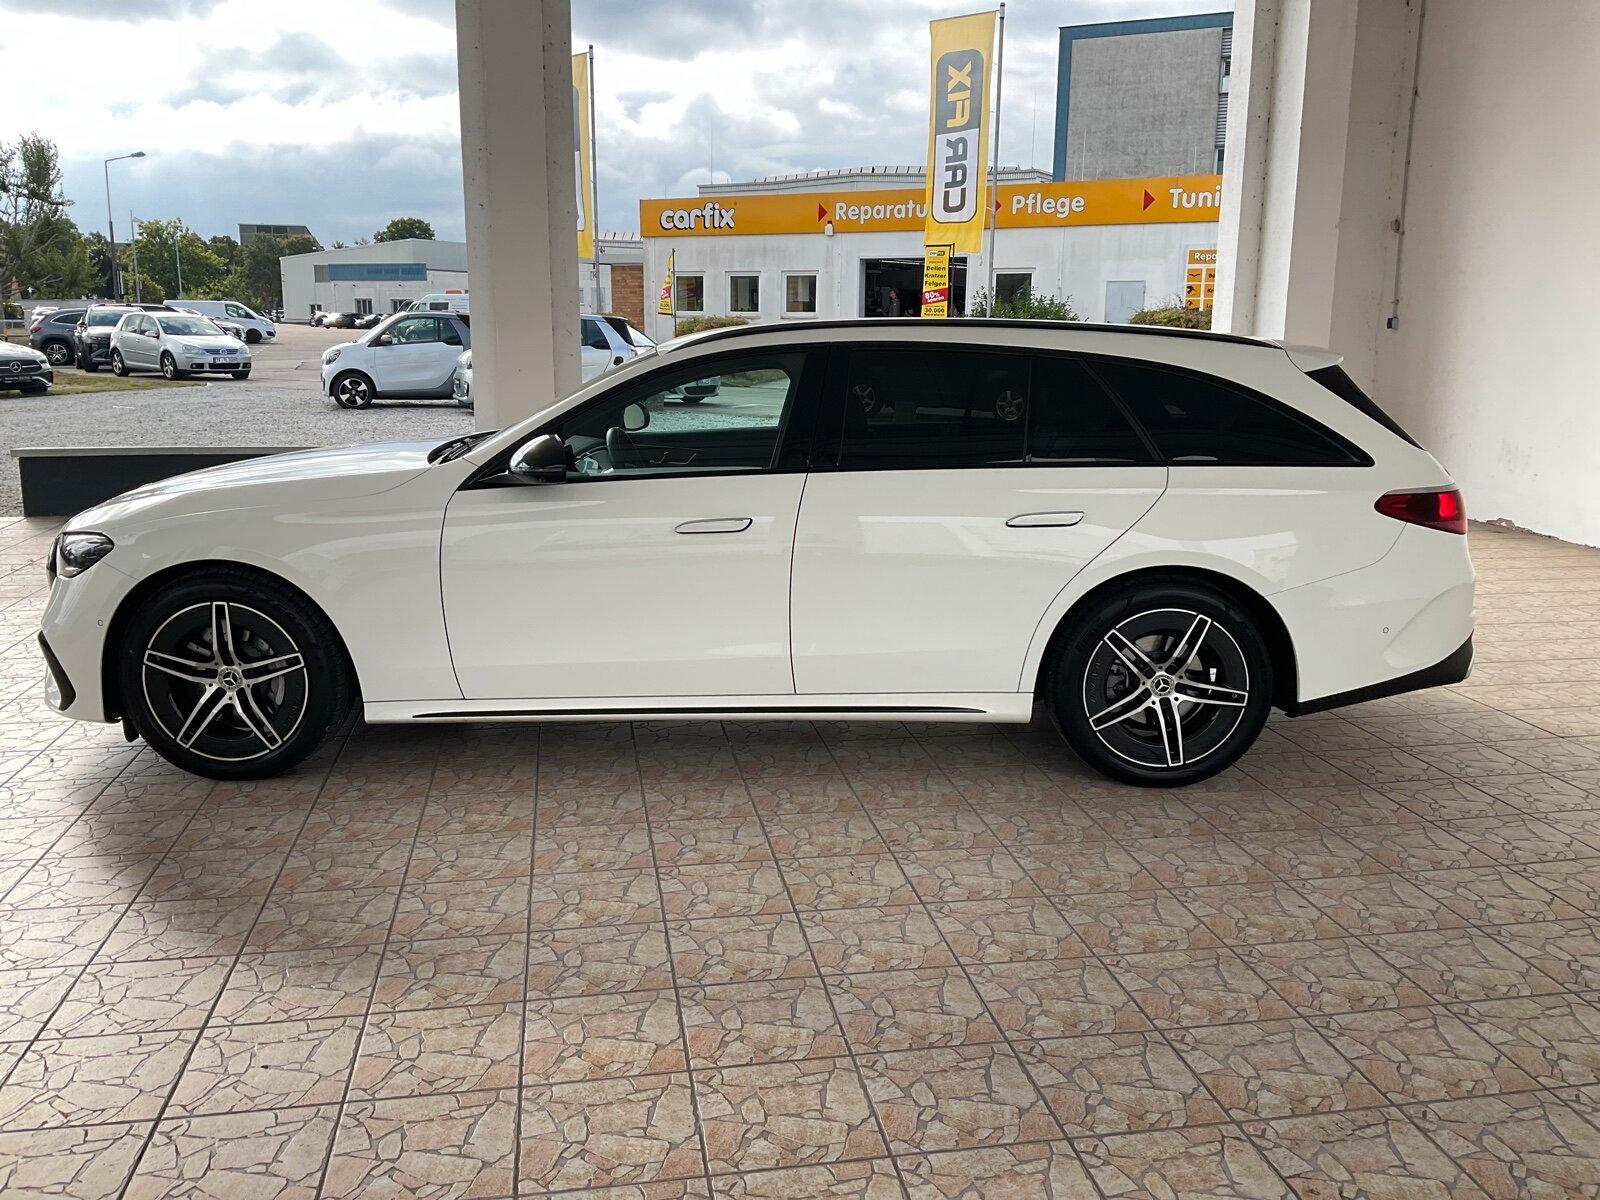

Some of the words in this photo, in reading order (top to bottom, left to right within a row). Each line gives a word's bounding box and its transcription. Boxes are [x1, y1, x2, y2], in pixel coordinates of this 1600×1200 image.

[1012, 193, 1085, 218] Pflege
[1169, 185, 1221, 209] Tuni
[660, 202, 735, 230] carfix
[835, 200, 927, 225] Reparatu
